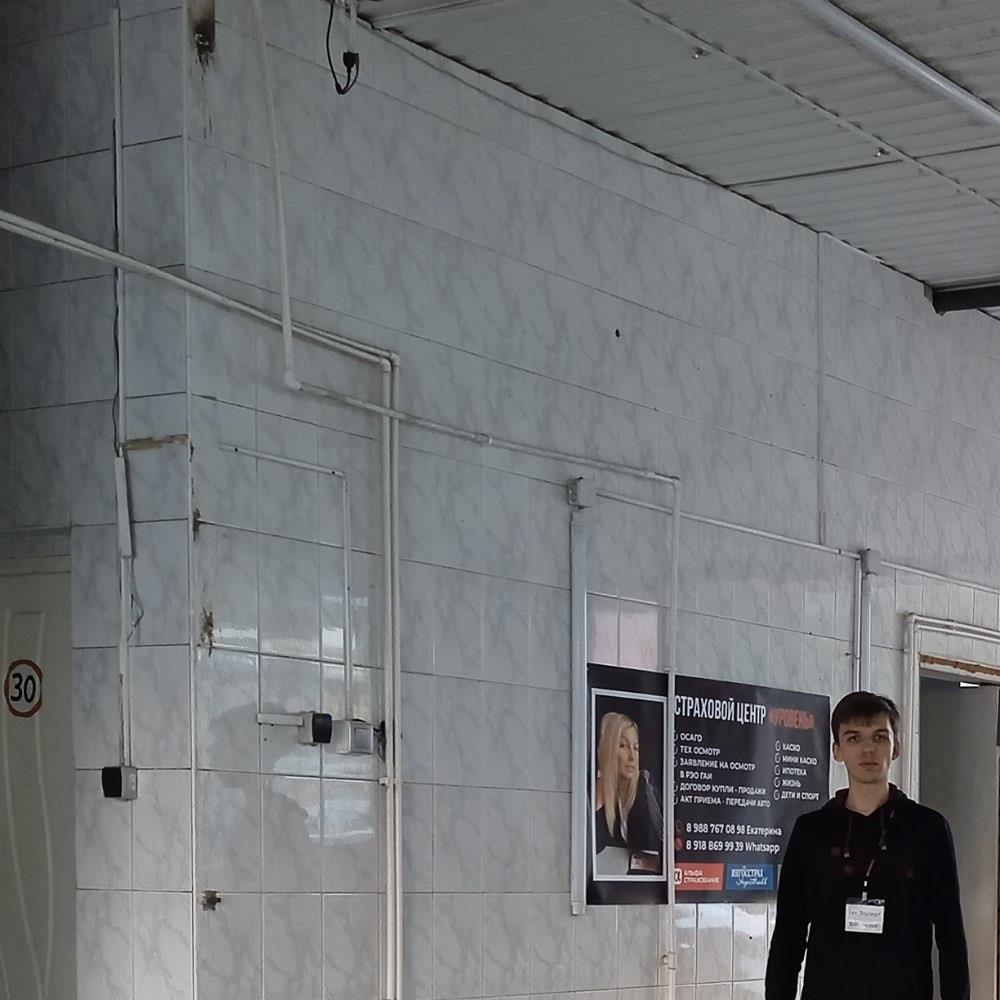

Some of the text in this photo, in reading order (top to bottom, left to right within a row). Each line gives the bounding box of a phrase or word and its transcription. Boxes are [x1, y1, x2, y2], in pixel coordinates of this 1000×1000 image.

[10, 672, 37, 704] 30
[674, 695, 735, 721] СТРАХОВОЙ
[737, 702, 766, 725] ЦЕНТР
[680, 732, 703, 742] ОСАГО
[680, 745, 720, 756] ТЕХ ОСМОТР
[782, 743, 801, 752] КАСКО
[680, 758, 756, 771] ЗАЯВЛЕНИЕ НА ОСМОТР
[782, 755, 818, 766] МИНИ КАСКО
[680, 770, 684, 778] В
[700, 772, 713, 780] ГАИ
[782, 767, 807, 776] ИПОТЕКА
[680, 782, 711, 792] ДОГОВОР
[711, 784, 734, 793] КУПЛИ
[738, 786, 766, 795] ПРОДАЖИ
[782, 779, 801, 788] ЖИЗНЬ
[781, 790, 819, 801] ДЕТИ И СПОРТ
[680, 795, 693, 803] АКТ
[693, 796, 721, 805] ПРИЕМА
[725, 798, 756, 807] ПЕРЕДАЧИ
[756, 800, 771, 808] АВТО
[686, 822, 782, 837] 8 988 767 08 98 Екатерина
[686, 840, 780, 854] 8 918 869 99 39 Whatsapp
